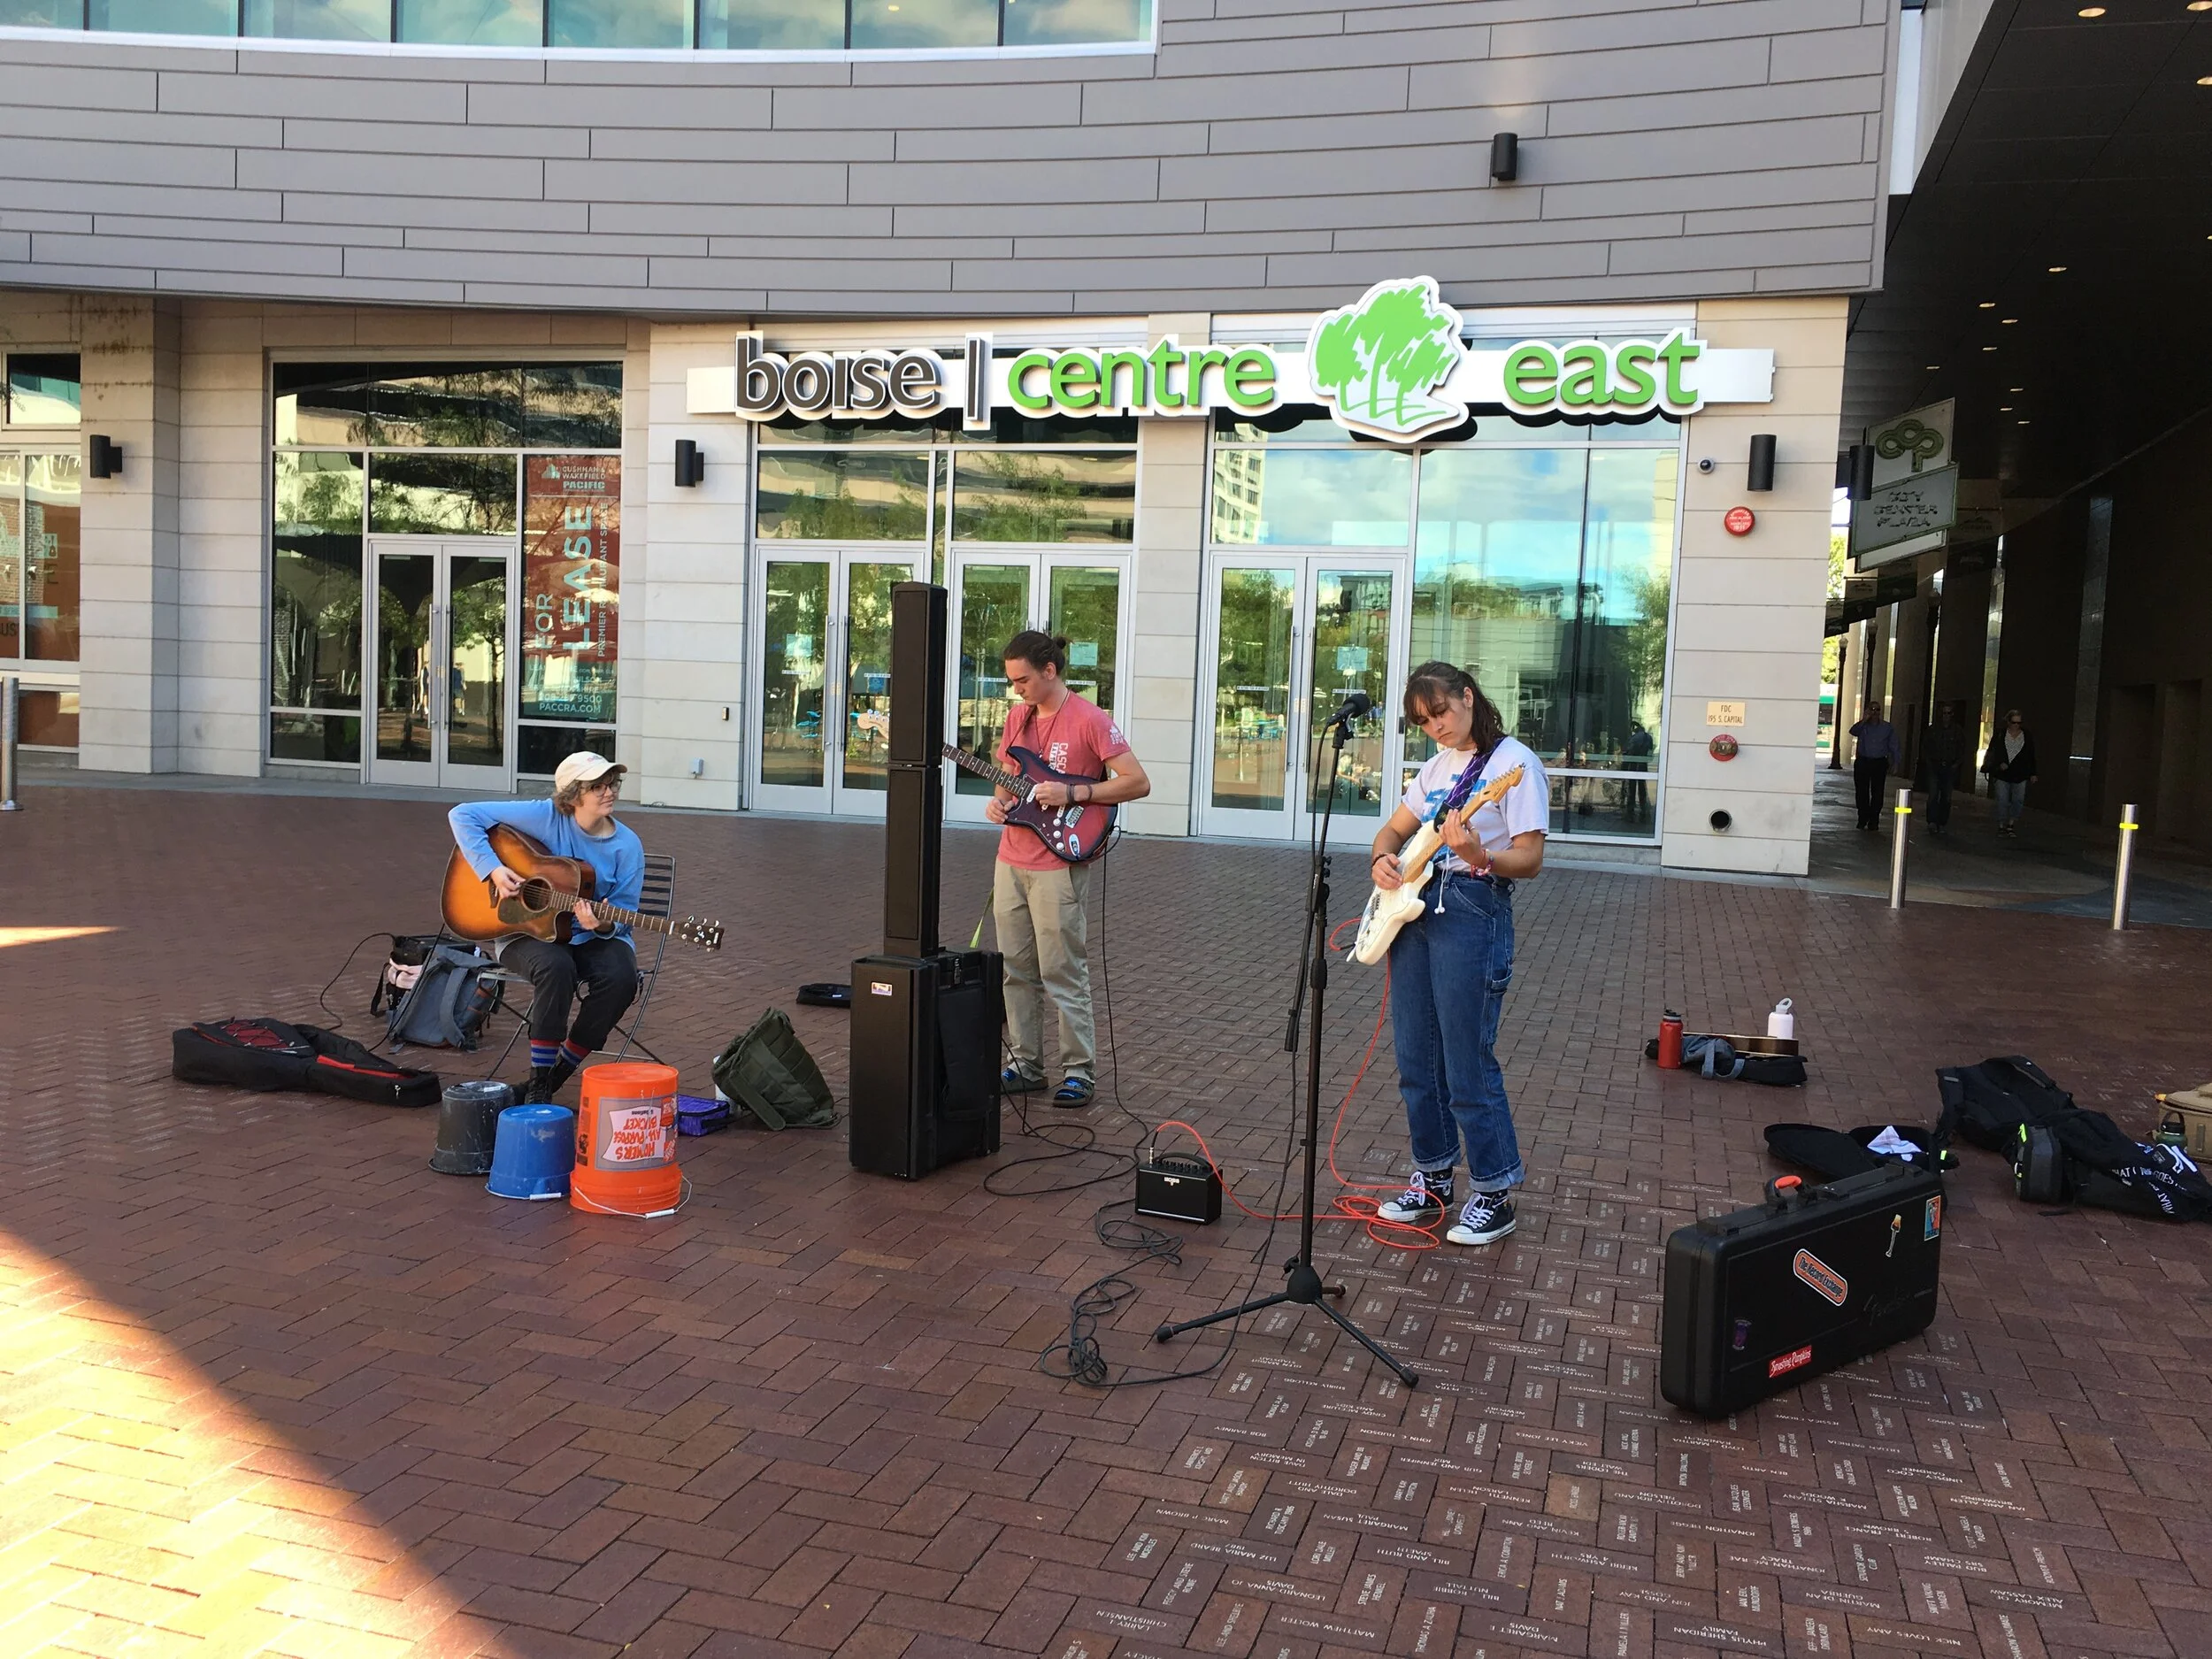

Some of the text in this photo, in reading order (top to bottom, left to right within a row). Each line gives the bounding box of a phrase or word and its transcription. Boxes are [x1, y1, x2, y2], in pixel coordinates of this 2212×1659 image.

[734, 331, 1701, 412] boise centre east
[563, 480, 606, 489] PACIFIC
[563, 505, 593, 651] LEASE
[534, 593, 553, 650] FOR
[597, 611, 606, 657] PREMIER
[539, 703, 602, 713] PACCRA.COM
[1720, 704, 1732, 713] FDC
[1724, 715, 1743, 724] CAPITAL
[1405, 1553, 1428, 1562] AND
[1266, 1579, 1295, 1590] DAVIS
[1509, 1622, 1540, 1632] DAVIS
[1673, 1625, 1727, 1640] SHERIDAN
[1701, 1624, 1739, 1636] FAMILY
[1866, 1625, 1962, 1647] NICK LOVES AMY
